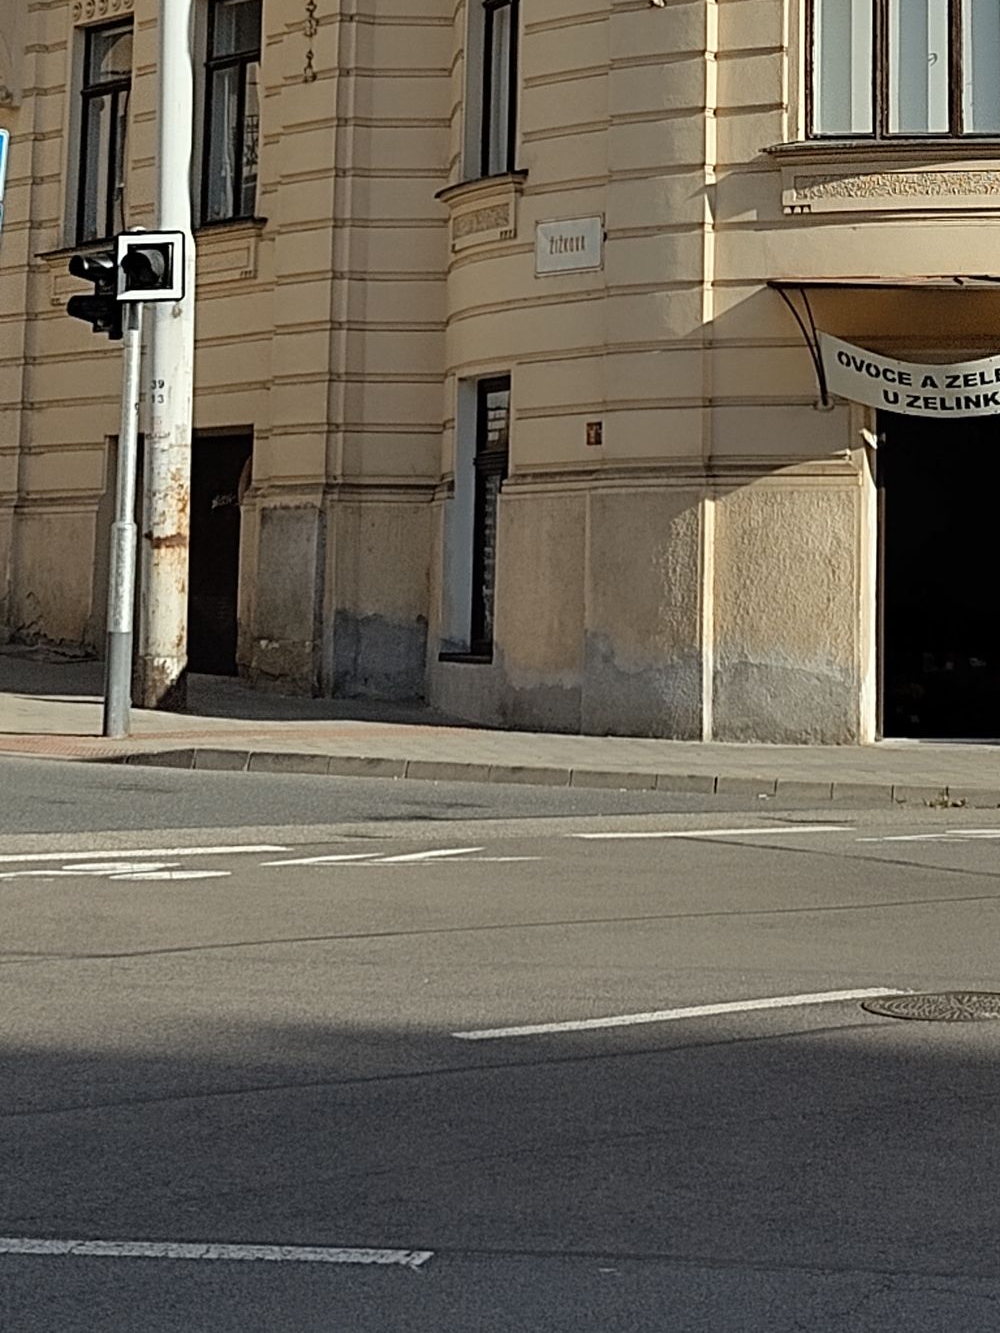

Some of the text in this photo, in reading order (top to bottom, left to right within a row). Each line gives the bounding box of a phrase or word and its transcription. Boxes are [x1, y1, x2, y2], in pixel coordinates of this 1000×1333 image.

[836, 349, 912, 387] OVOCE
[920, 374, 938, 389] A
[882, 389, 899, 405] U
